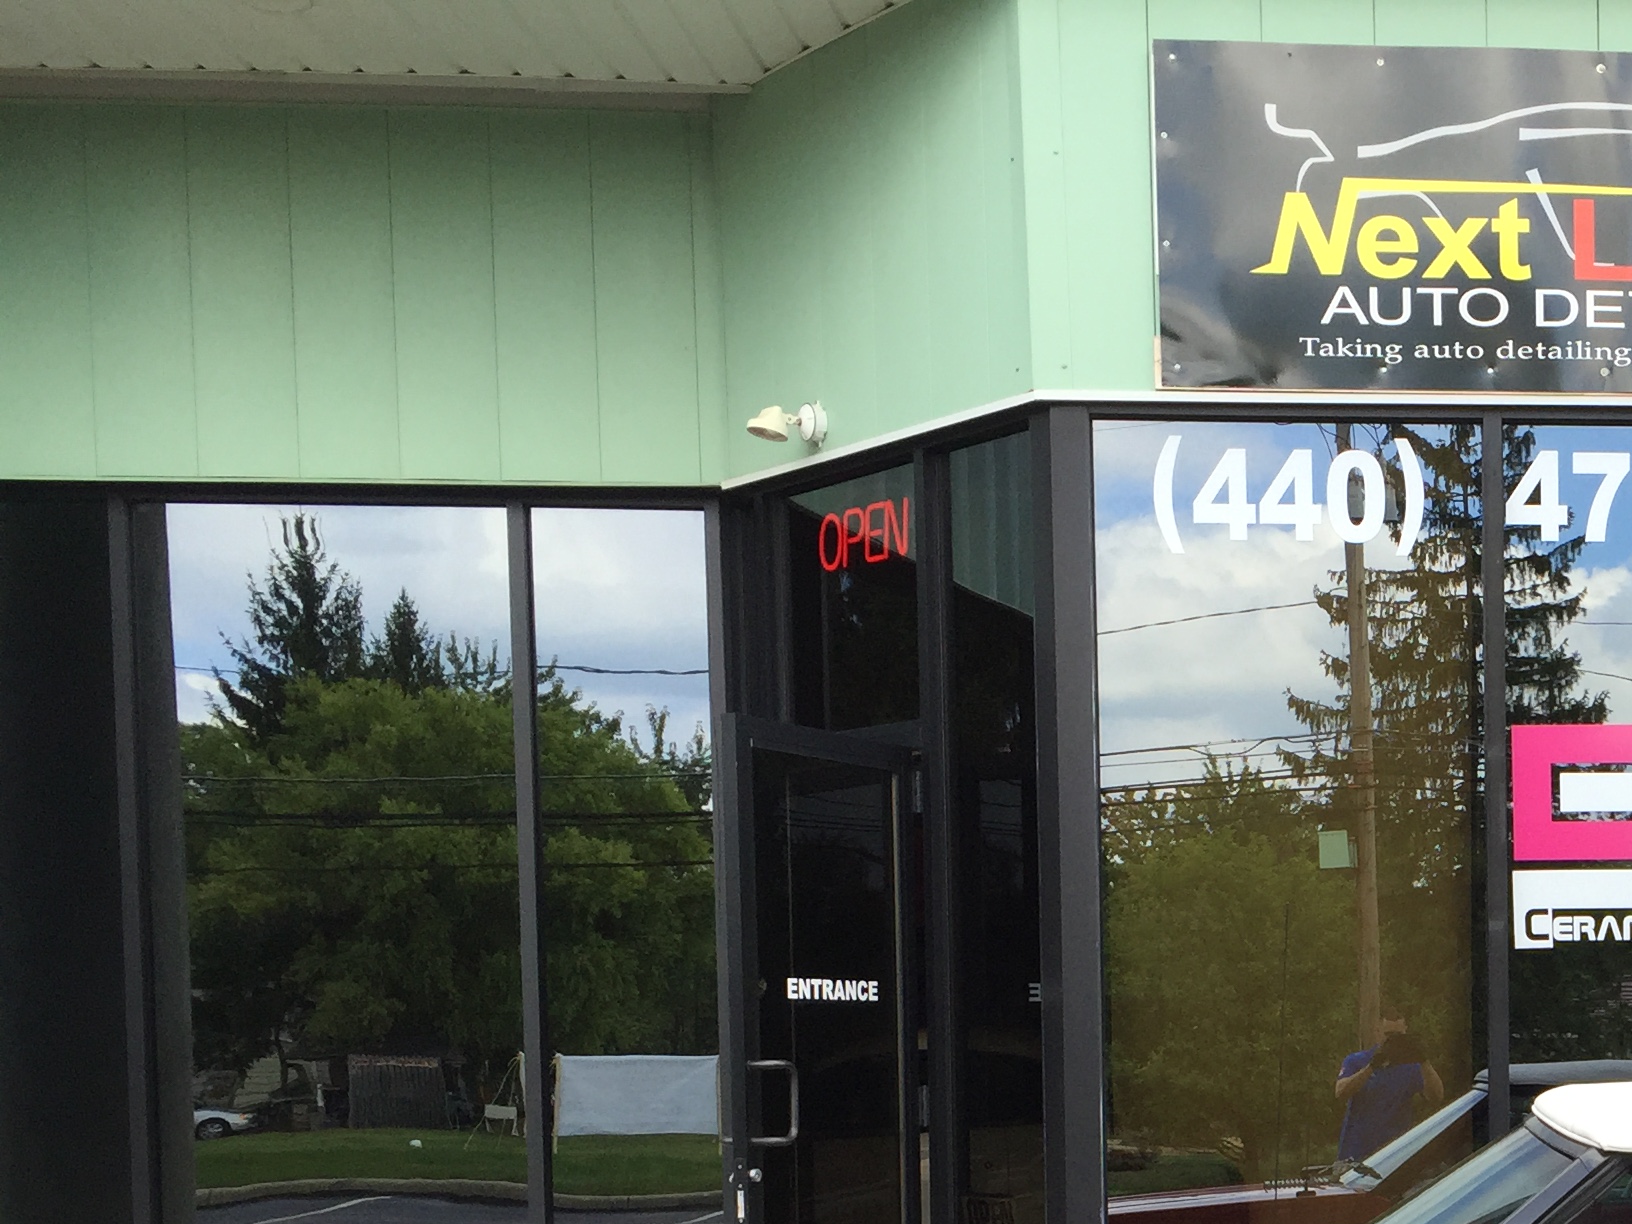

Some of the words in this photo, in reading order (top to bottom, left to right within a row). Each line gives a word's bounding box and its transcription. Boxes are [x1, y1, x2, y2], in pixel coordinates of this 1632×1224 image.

[1250, 177, 1533, 282] Next
[1320, 286, 1510, 328] AUTO
[1298, 337, 1403, 365] Taking
[1413, 341, 1485, 360] auto
[1495, 340, 1632, 367] detailing
[1152, 435, 1426, 556] (440)
[818, 496, 910, 573] OPEN
[786, 977, 879, 1002] ENTRANCE
